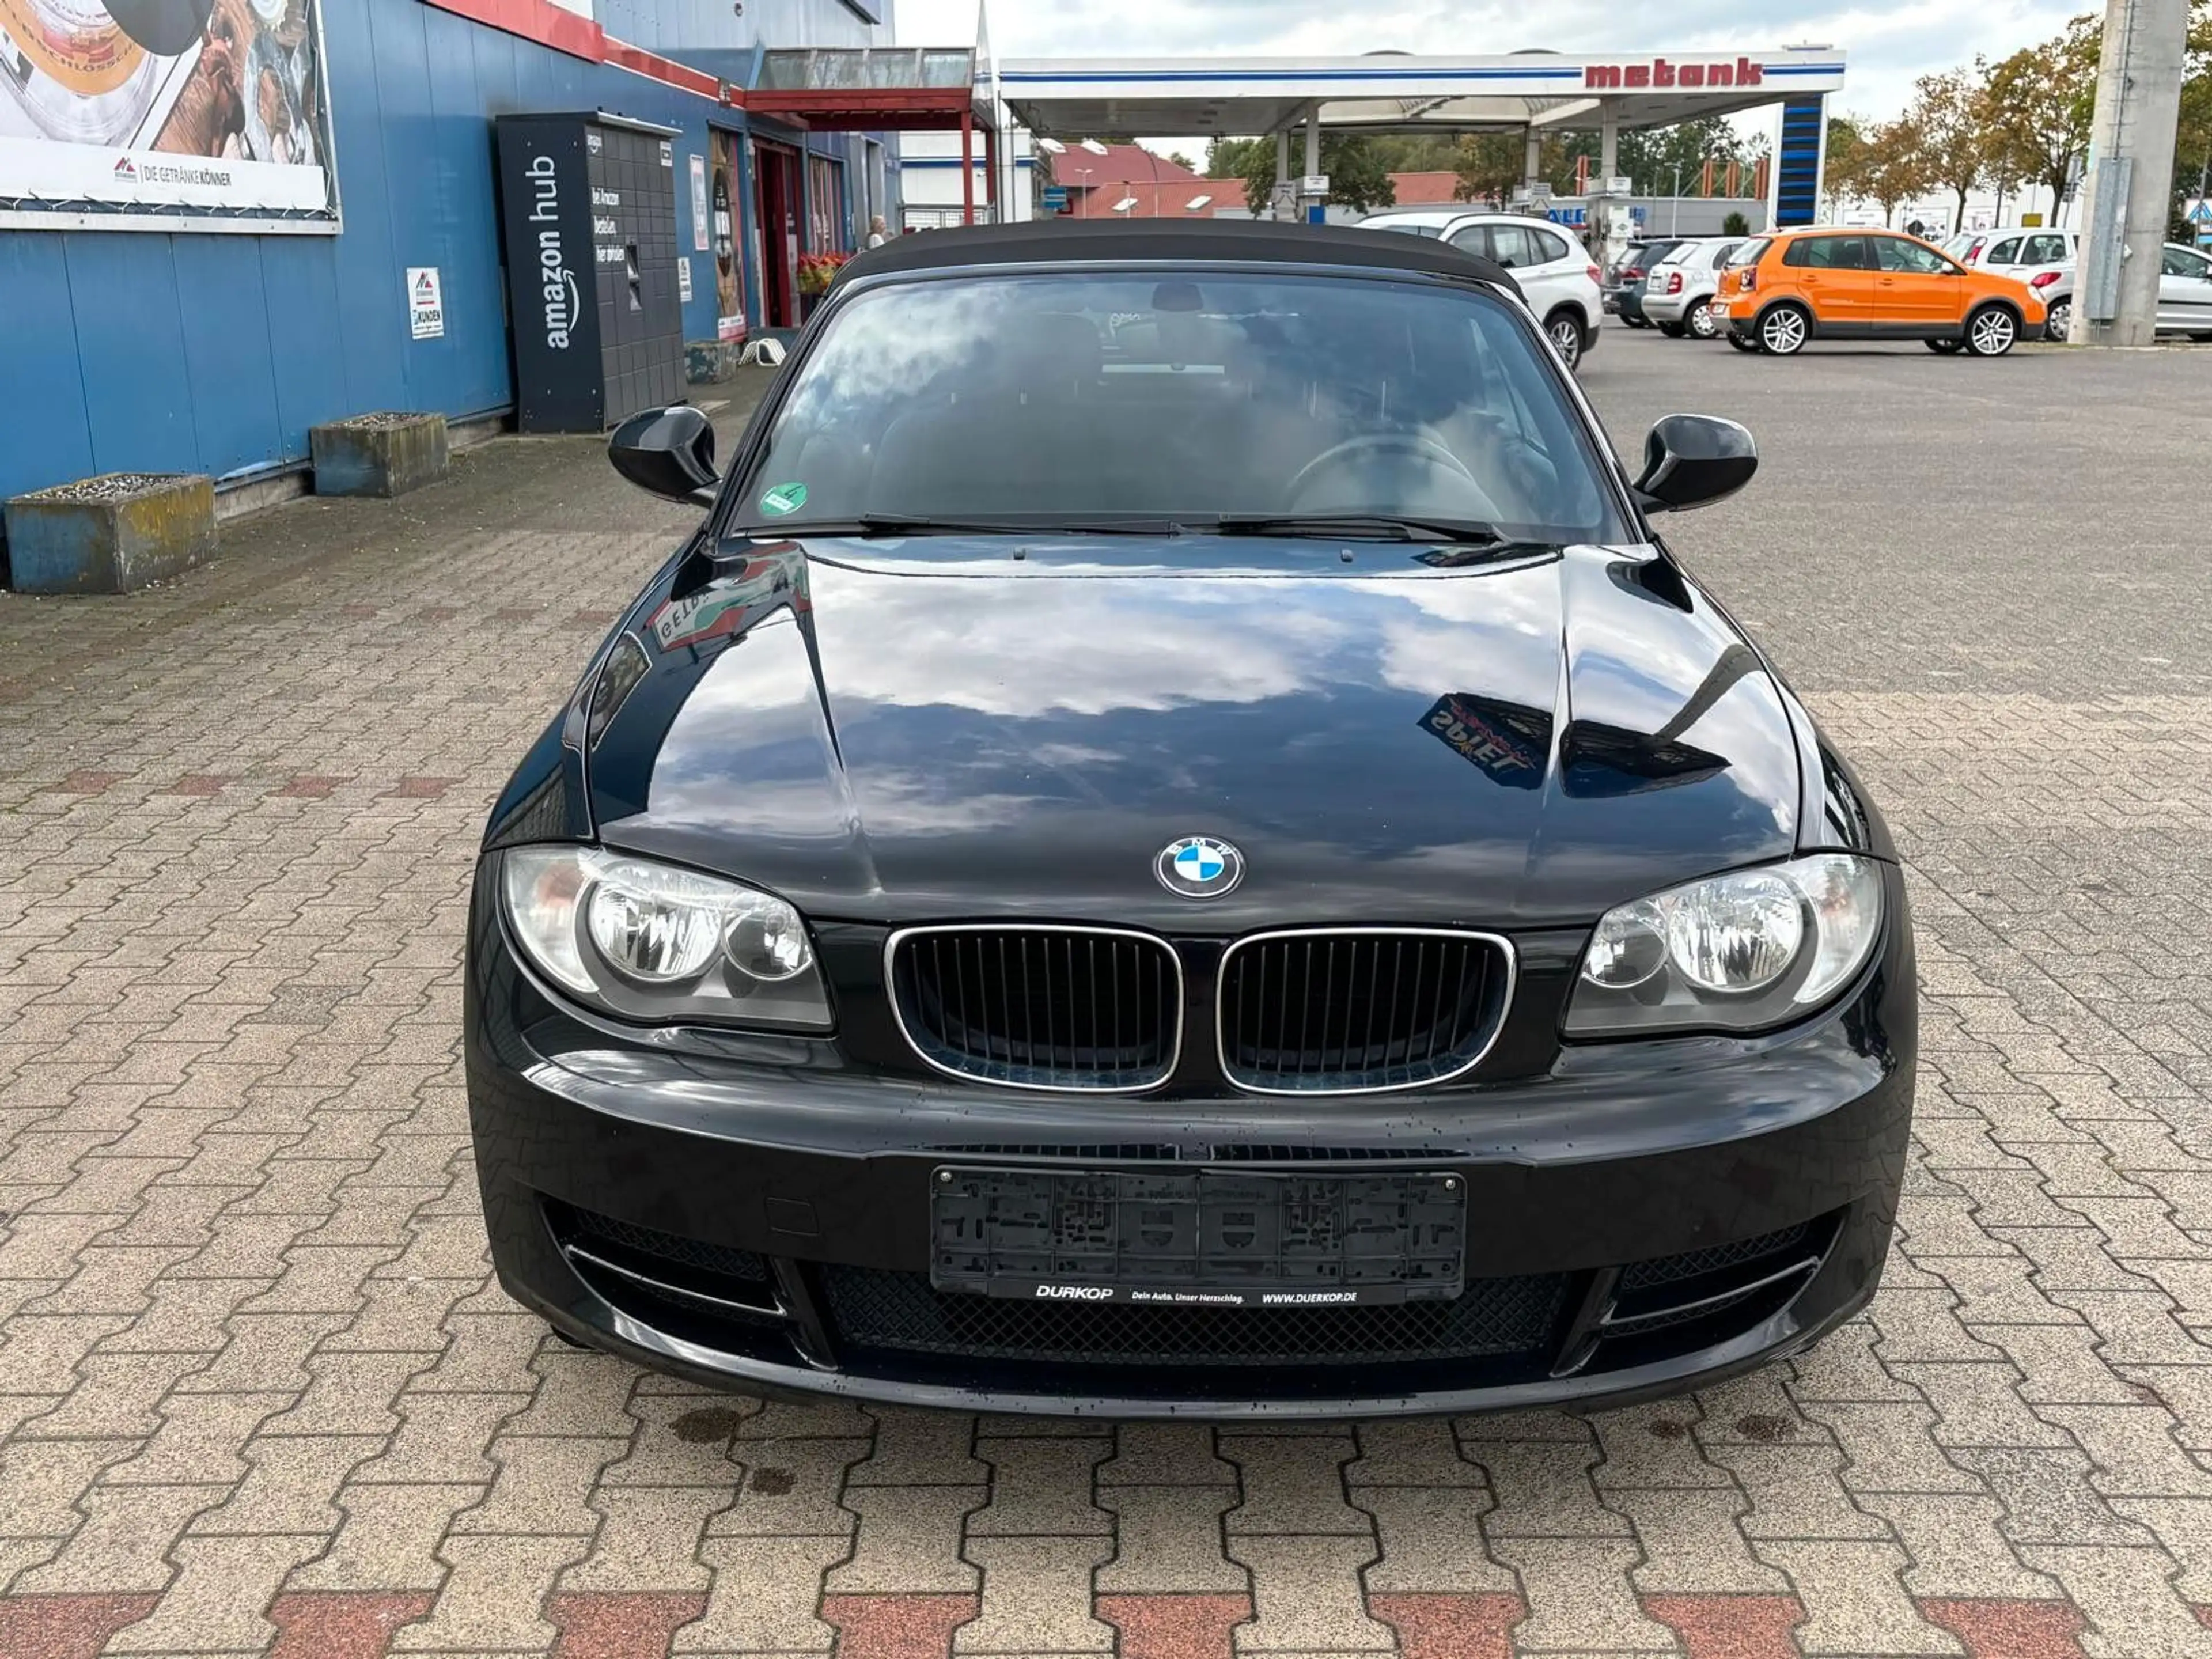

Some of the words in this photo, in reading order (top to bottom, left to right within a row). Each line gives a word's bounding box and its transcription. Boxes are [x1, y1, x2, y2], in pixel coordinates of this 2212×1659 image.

[1585, 57, 1763, 88] metank
[144, 165, 158, 182] DIE
[525, 156, 559, 221] hub
[539, 230, 570, 349] amazon
[1166, 838, 1232, 855] BMW
[1132, 1291, 1151, 1300] Dein
[1175, 1293, 1198, 1301] Unser
[1262, 1291, 1358, 1304] WWW.DUERKOP.DE
